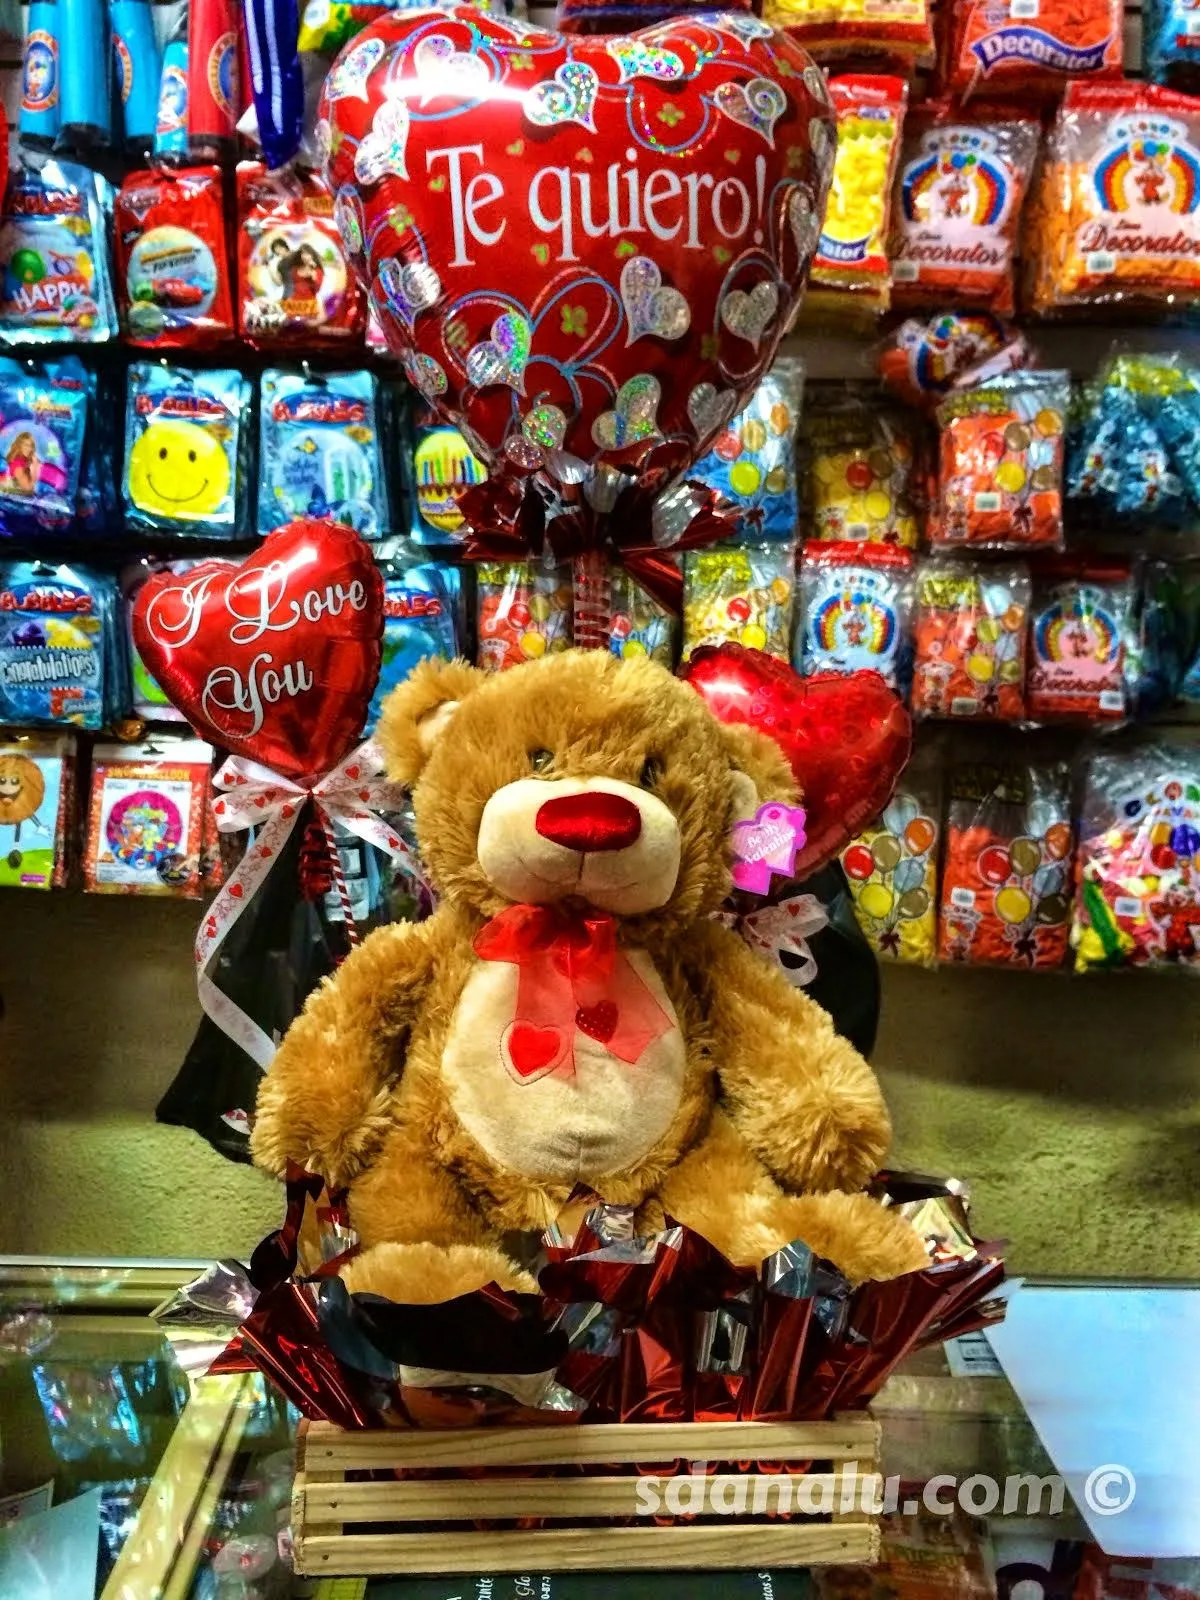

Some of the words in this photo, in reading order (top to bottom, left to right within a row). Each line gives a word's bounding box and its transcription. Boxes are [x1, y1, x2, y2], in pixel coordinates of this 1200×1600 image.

[426, 144, 506, 268] Te
[528, 147, 766, 262] quiero!
[12, 280, 85, 310] HAPPY
[146, 570, 224, 648] I
[225, 561, 367, 645] Love
[202, 653, 313, 739] You
